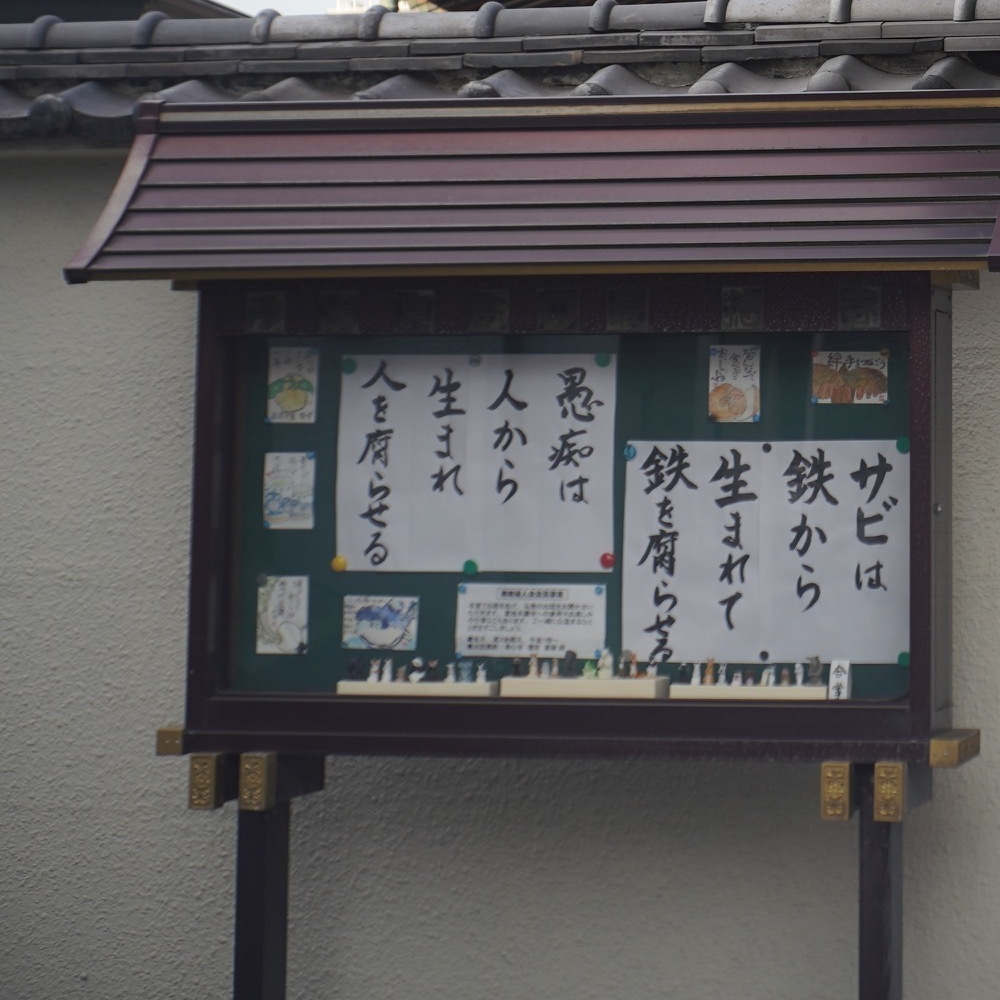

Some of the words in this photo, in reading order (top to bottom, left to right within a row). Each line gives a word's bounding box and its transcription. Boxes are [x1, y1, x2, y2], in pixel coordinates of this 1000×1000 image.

[355, 359, 408, 567] 人を腐らせる
[427, 366, 468, 497] 生まれ
[486, 367, 529, 505] 人から
[547, 366, 605, 505] 愚痴は
[635, 443, 699, 666] 鉄を腐らせる
[708, 447, 759, 631] 生まれて
[782, 447, 840, 613] 鉄から
[849, 451, 899, 592] サビは
